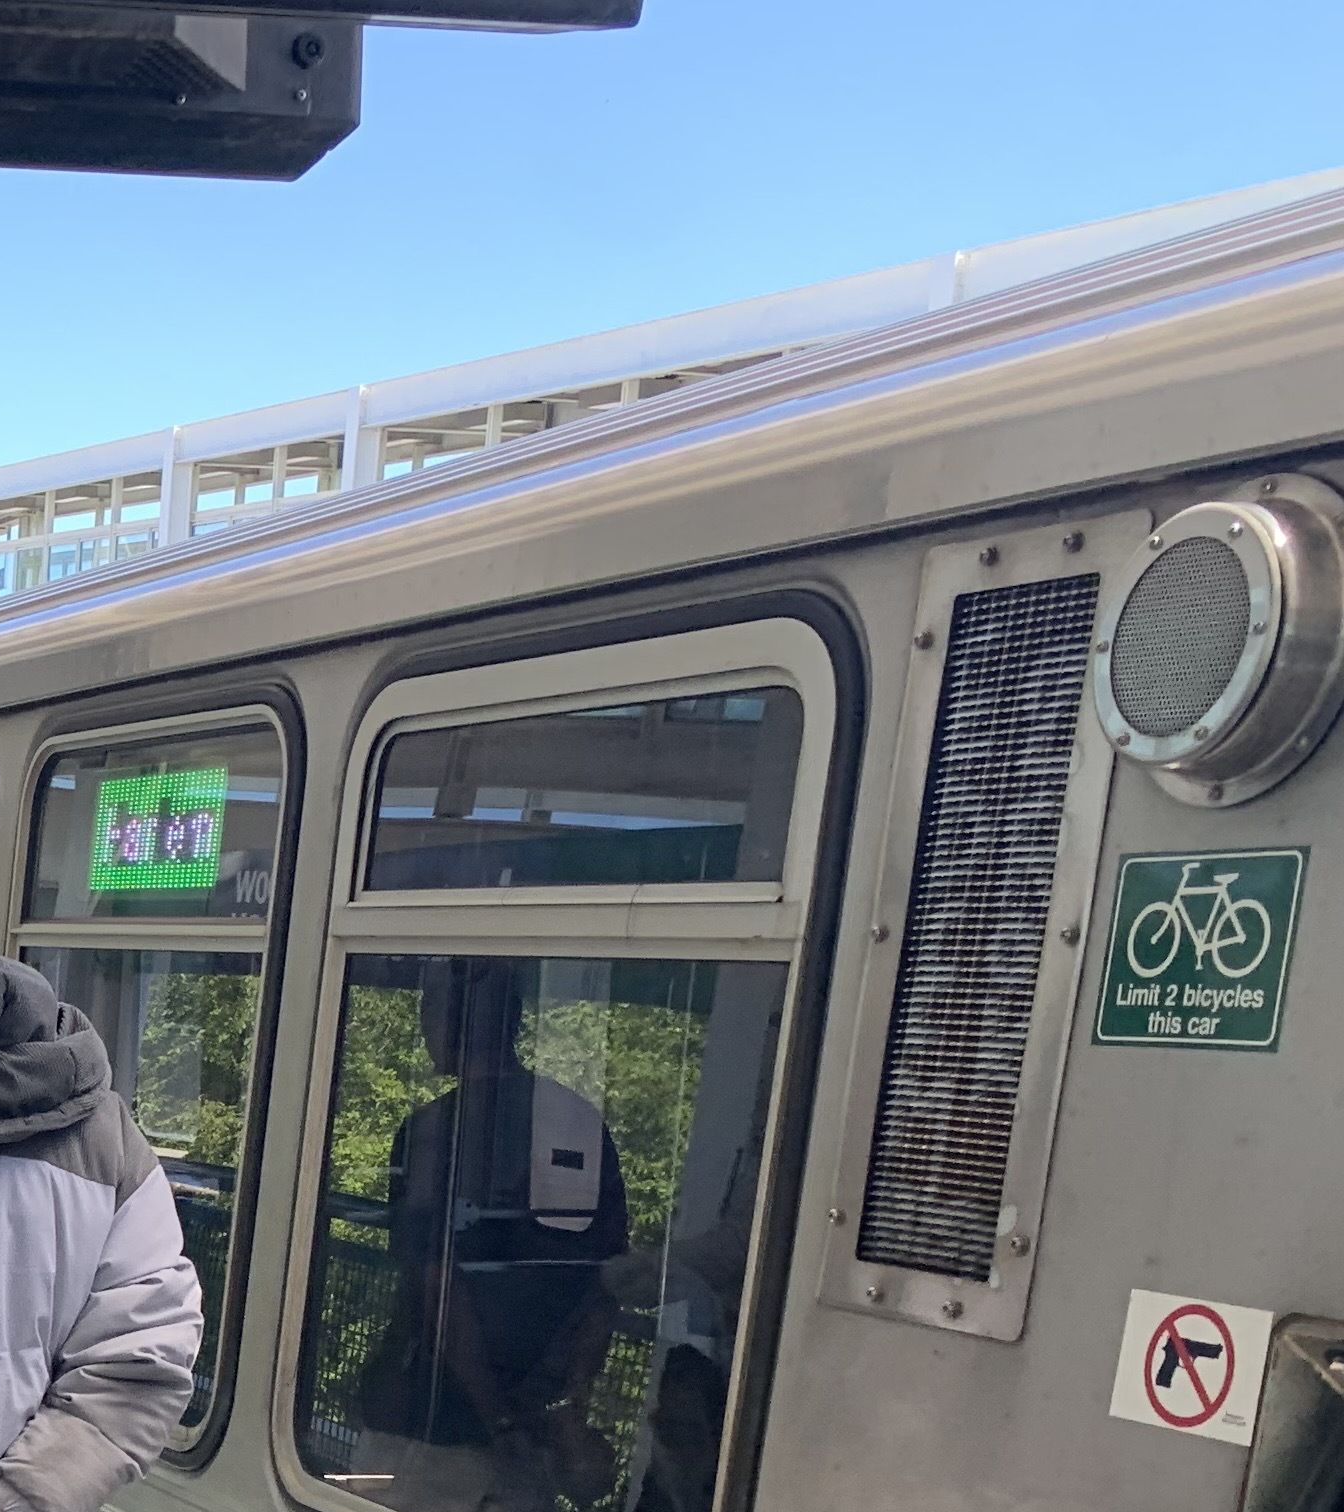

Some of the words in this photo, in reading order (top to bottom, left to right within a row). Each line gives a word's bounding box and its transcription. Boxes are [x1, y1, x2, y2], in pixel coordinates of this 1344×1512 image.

[1116, 983, 1160, 1007] Limit
[1165, 984, 1178, 1007] 2
[1183, 983, 1265, 1013] bicycles
[1148, 1010, 1181, 1034] this
[1187, 1016, 1221, 1035] car
